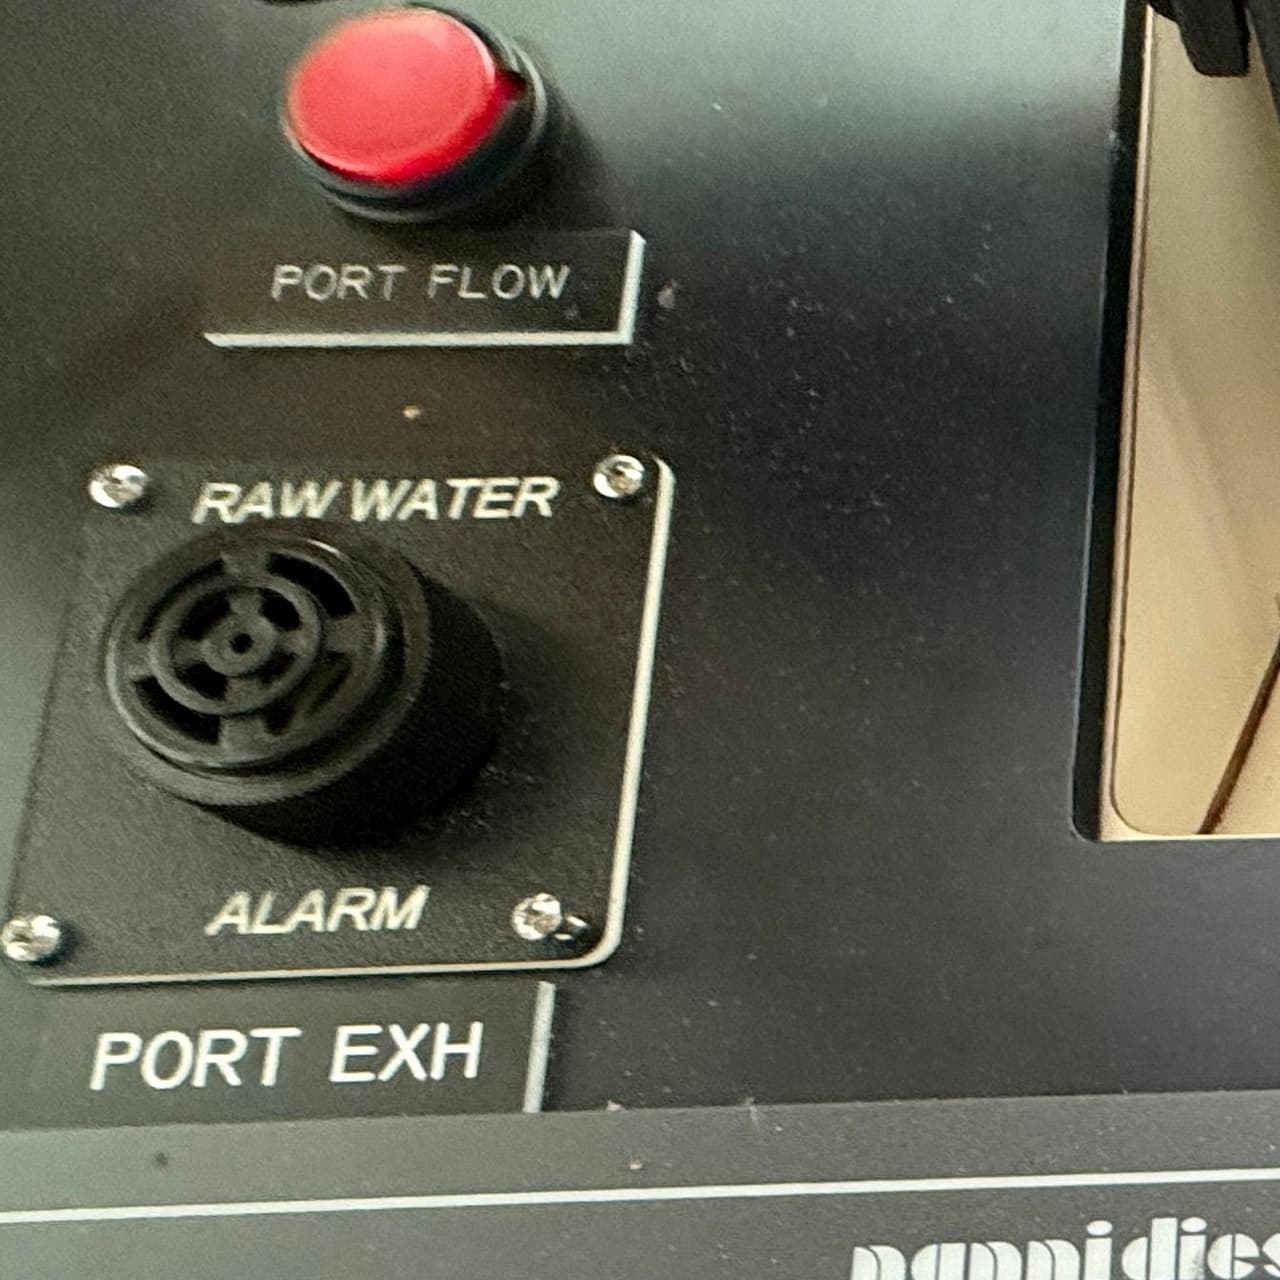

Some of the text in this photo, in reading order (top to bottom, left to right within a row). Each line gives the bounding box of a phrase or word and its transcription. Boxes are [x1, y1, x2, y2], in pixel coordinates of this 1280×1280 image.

[271, 262, 571, 302] PORT FLOW
[193, 477, 559, 525] RAW WATER
[205, 886, 430, 937] ALARM
[90, 1021, 483, 1092] PORT EXH
